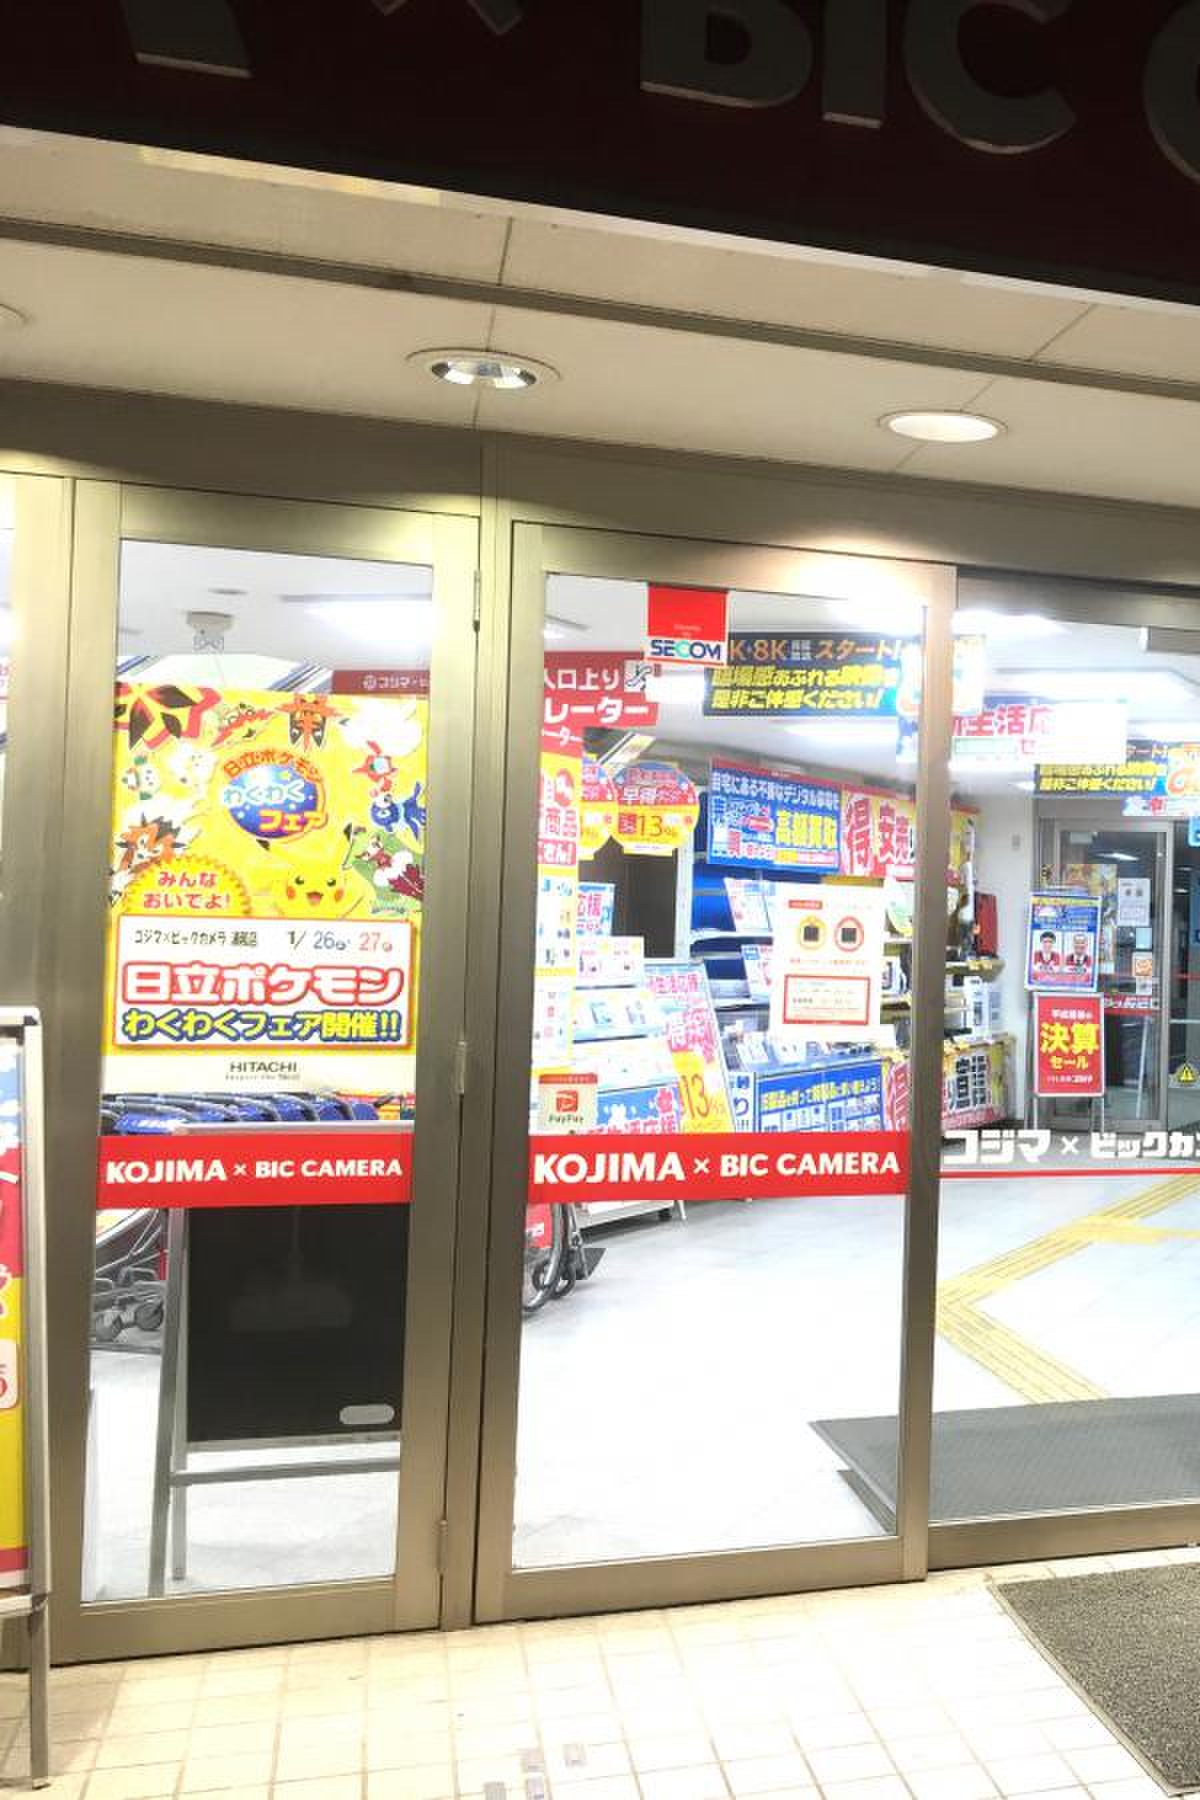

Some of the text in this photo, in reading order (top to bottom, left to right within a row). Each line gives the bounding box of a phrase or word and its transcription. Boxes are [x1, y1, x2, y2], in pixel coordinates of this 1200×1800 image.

[650, 639, 721, 660] SECOM
[257, 808, 328, 833] フェア
[157, 870, 218, 888] みんな
[143, 892, 231, 910] おいてよ!
[122, 960, 404, 1006] 日立ポケモン
[122, 1007, 402, 1041] わくわくフェア開催!!
[1040, 1021, 1099, 1055] 決算
[229, 1061, 297, 1073] HITACHI
[1050, 1056, 1089, 1070] セール
[942, 1129, 1051, 1164] コジマ
[105, 1158, 227, 1185] KOJIMA
[255, 1160, 295, 1180] BIC
[301, 1156, 402, 1179] CAMERA
[534, 1152, 686, 1185] KOJIMA
[720, 1153, 769, 1177] BIC
[776, 1151, 900, 1175] CAMERA
